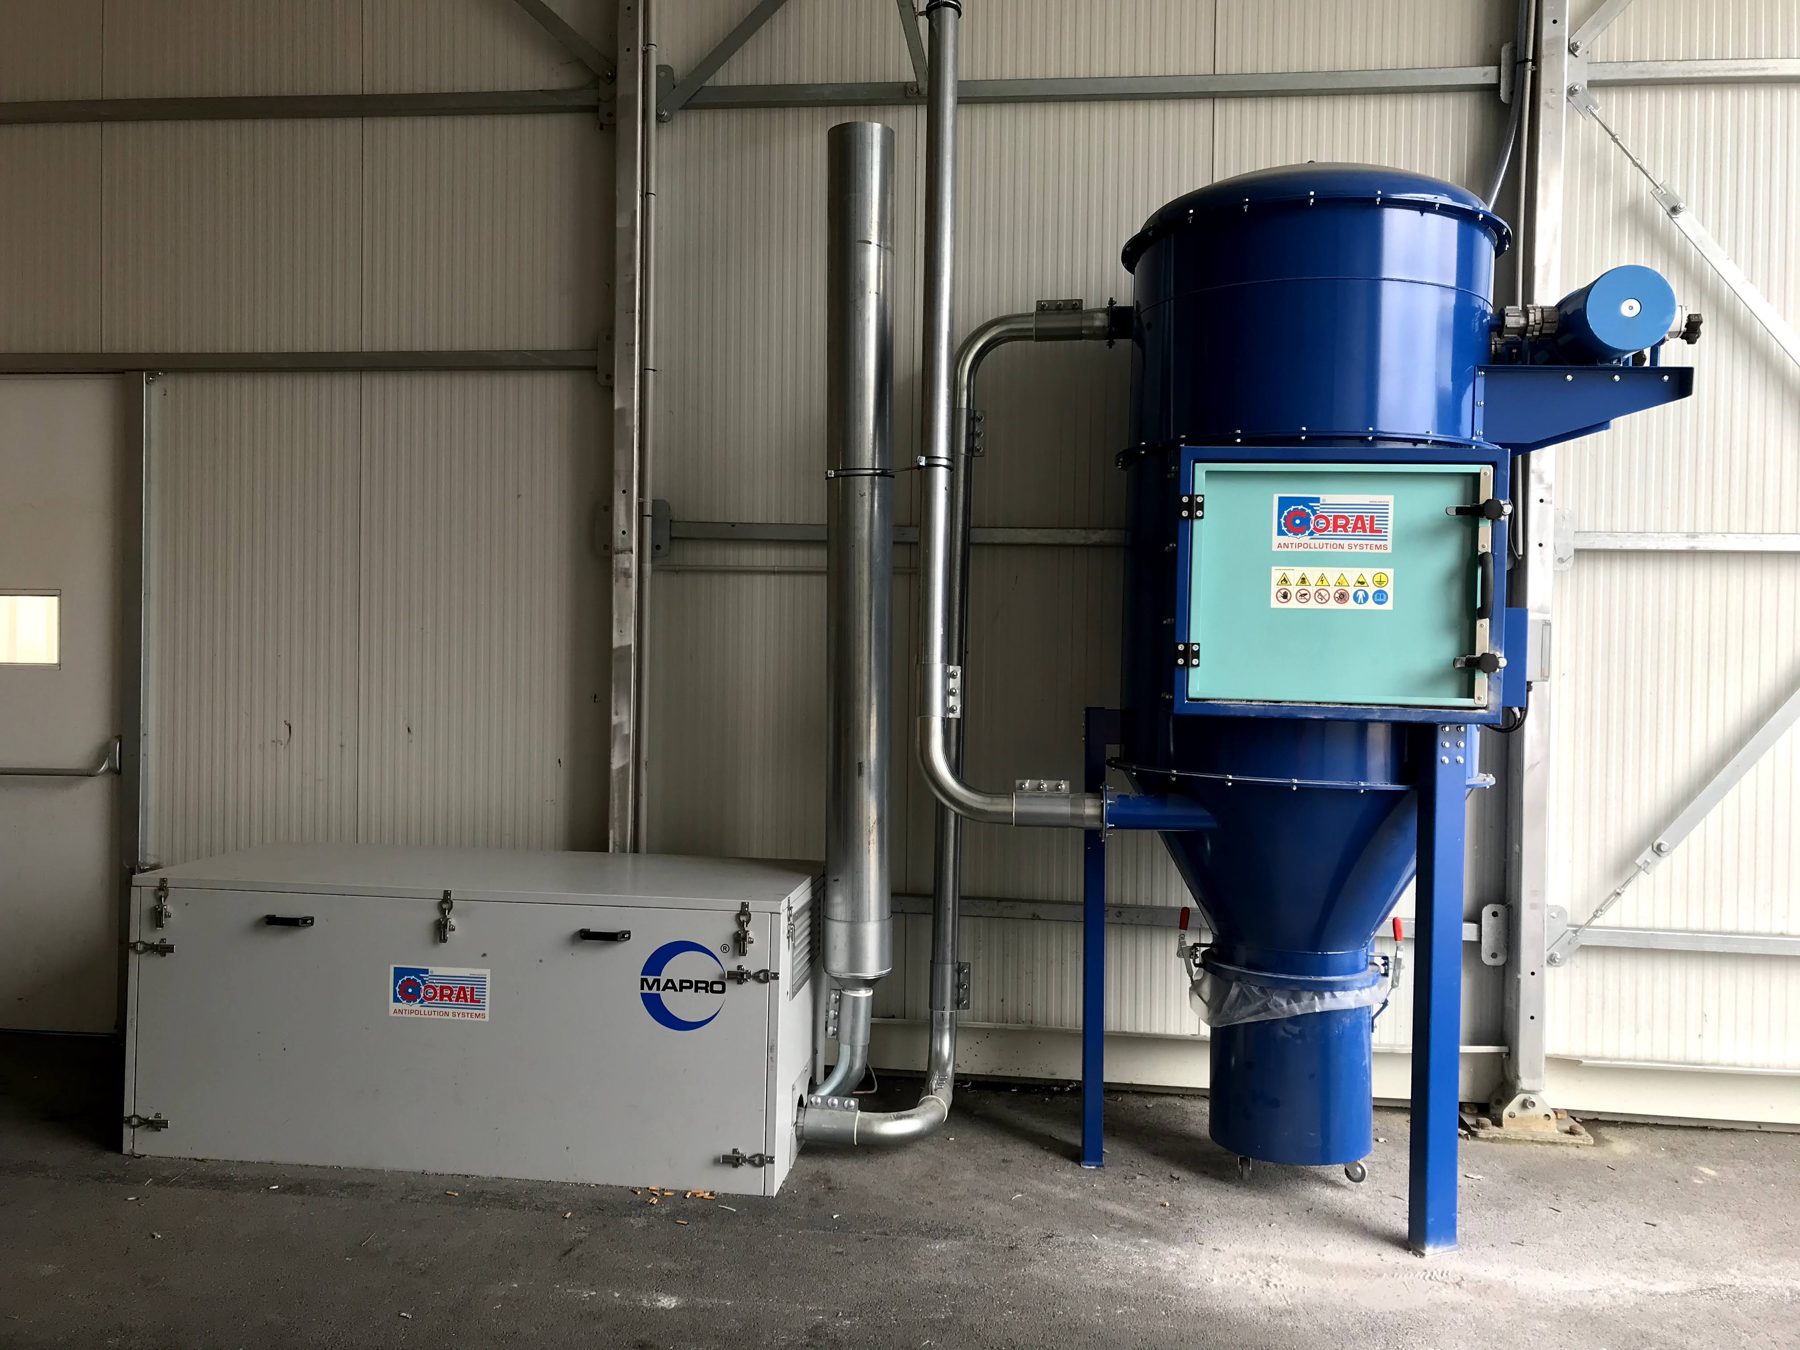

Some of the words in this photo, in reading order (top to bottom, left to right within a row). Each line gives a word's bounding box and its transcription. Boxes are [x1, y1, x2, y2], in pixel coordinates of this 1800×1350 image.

[1286, 510, 1383, 534] CORAL
[1277, 542, 1345, 550] ANTIPOLLUTION
[1347, 543, 1388, 551] SYSTEMS
[400, 979, 481, 1004] CORAL
[640, 977, 726, 995] MAPRO
[393, 1008, 450, 1017] ANTIPOLLUTION
[451, 1011, 486, 1020] SYSTEMS
